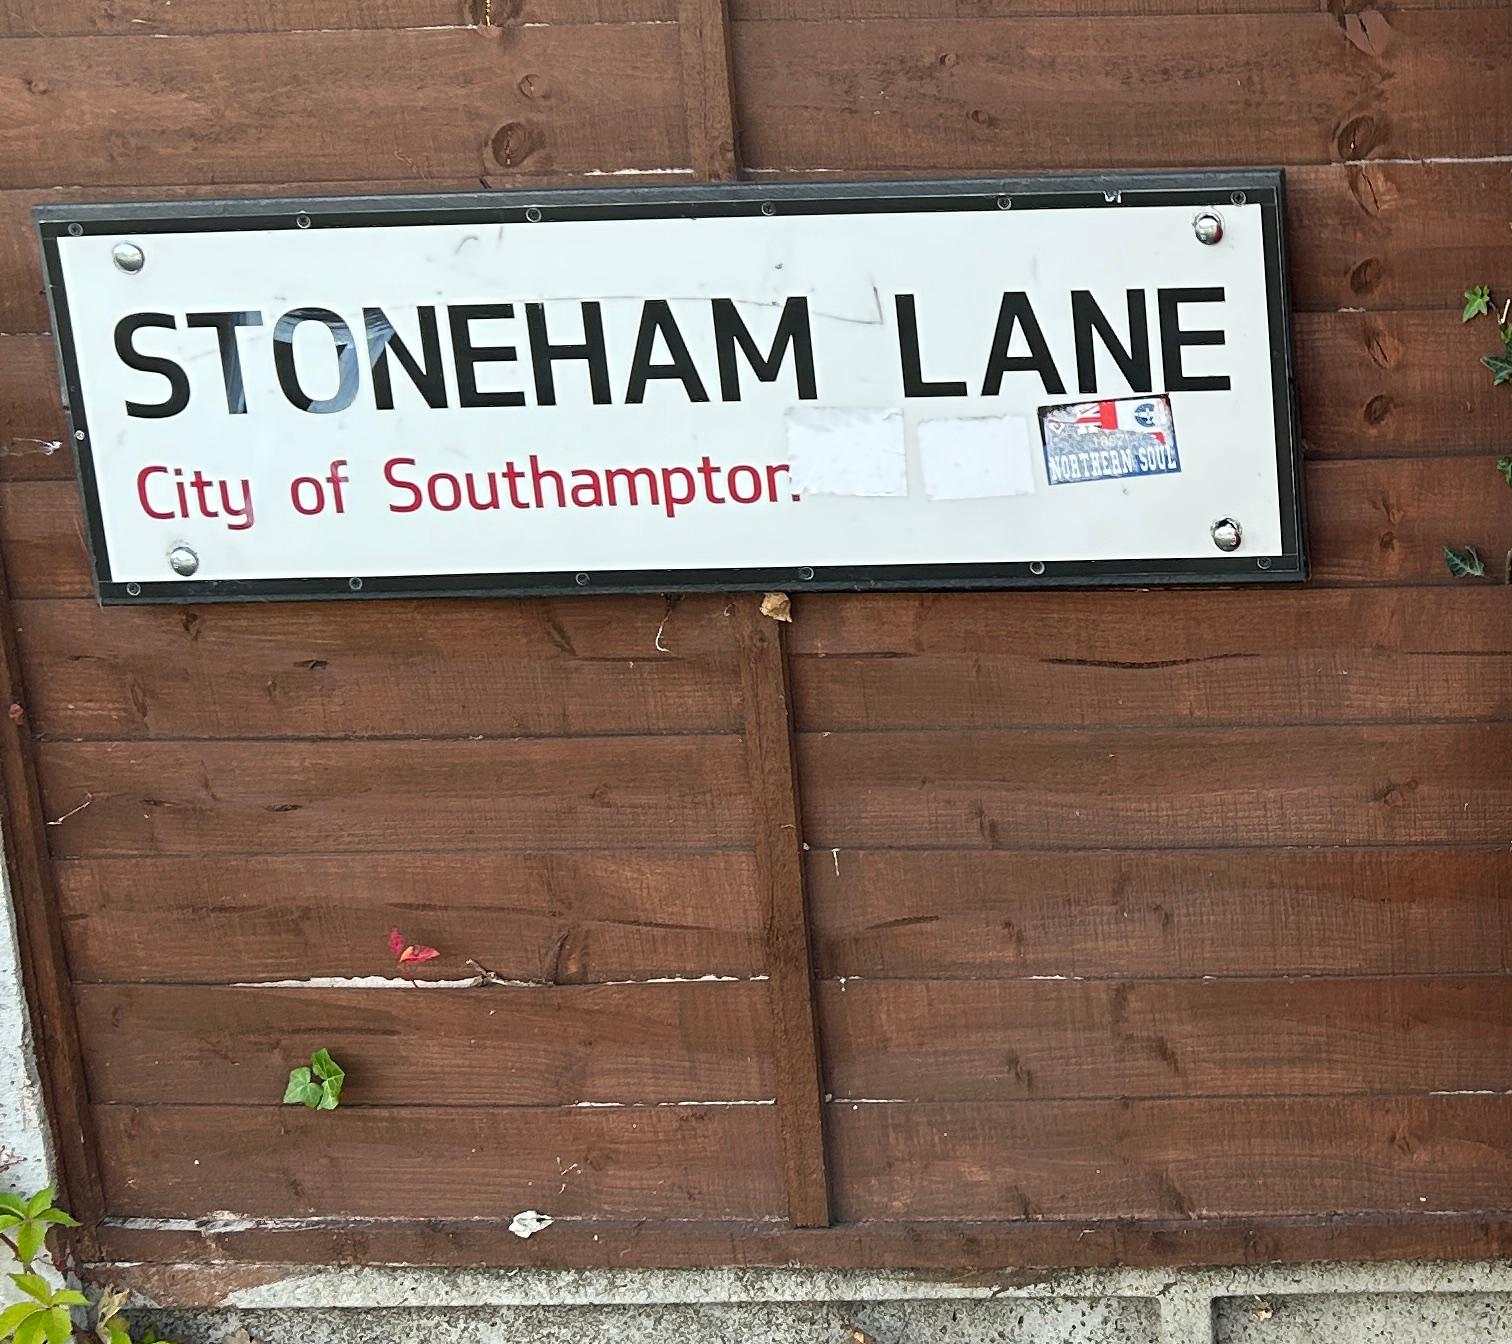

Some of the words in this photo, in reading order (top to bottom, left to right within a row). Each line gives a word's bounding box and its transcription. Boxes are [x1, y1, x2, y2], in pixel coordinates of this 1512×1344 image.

[113, 295, 818, 419] STONEHAM
[894, 286, 1232, 398] LANE
[136, 464, 256, 531] City
[289, 459, 349, 516] of
[1048, 447, 1134, 481] NORTHERN
[1138, 445, 1177, 472] SOUL
